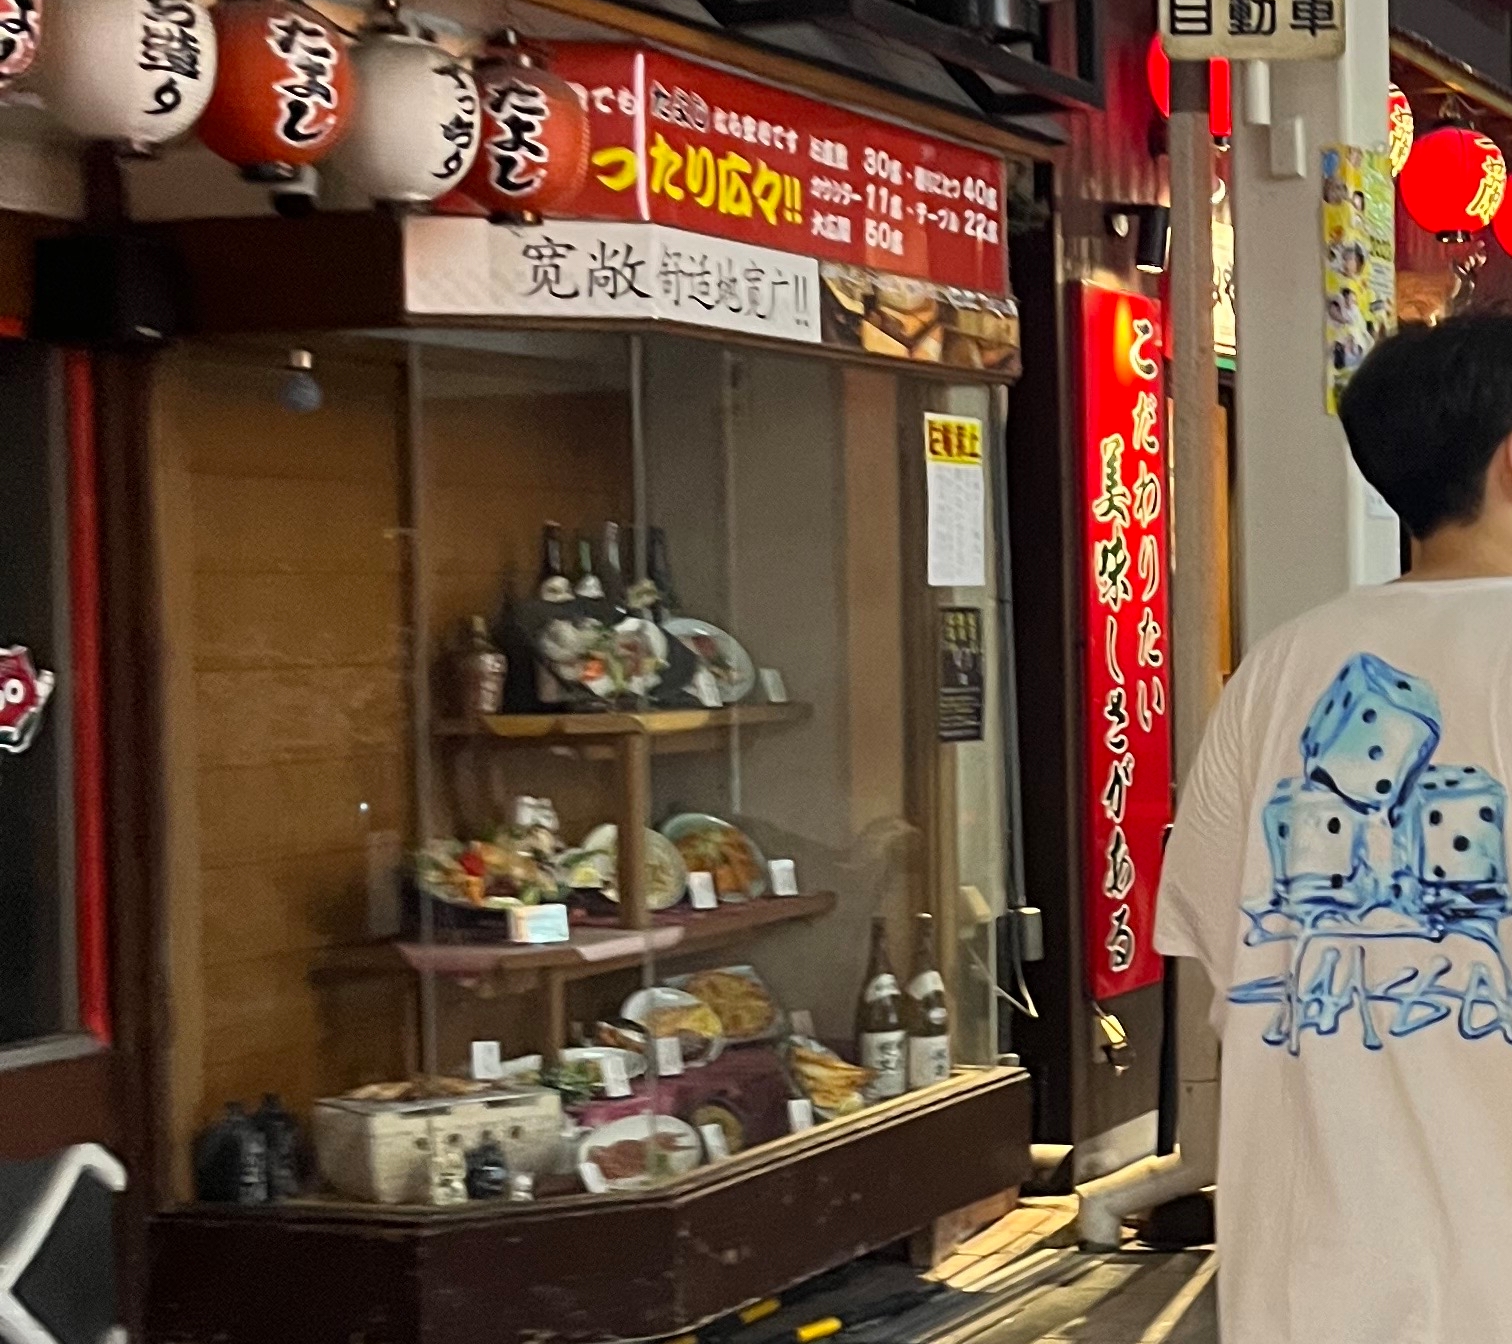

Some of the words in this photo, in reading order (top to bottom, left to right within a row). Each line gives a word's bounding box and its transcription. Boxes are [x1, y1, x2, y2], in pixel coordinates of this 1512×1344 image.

[268, 16, 338, 148] たよし
[484, 79, 552, 196] たよし
[1129, 316, 1167, 733] こだわりたい
[1092, 432, 1136, 973] 美味しさがある
